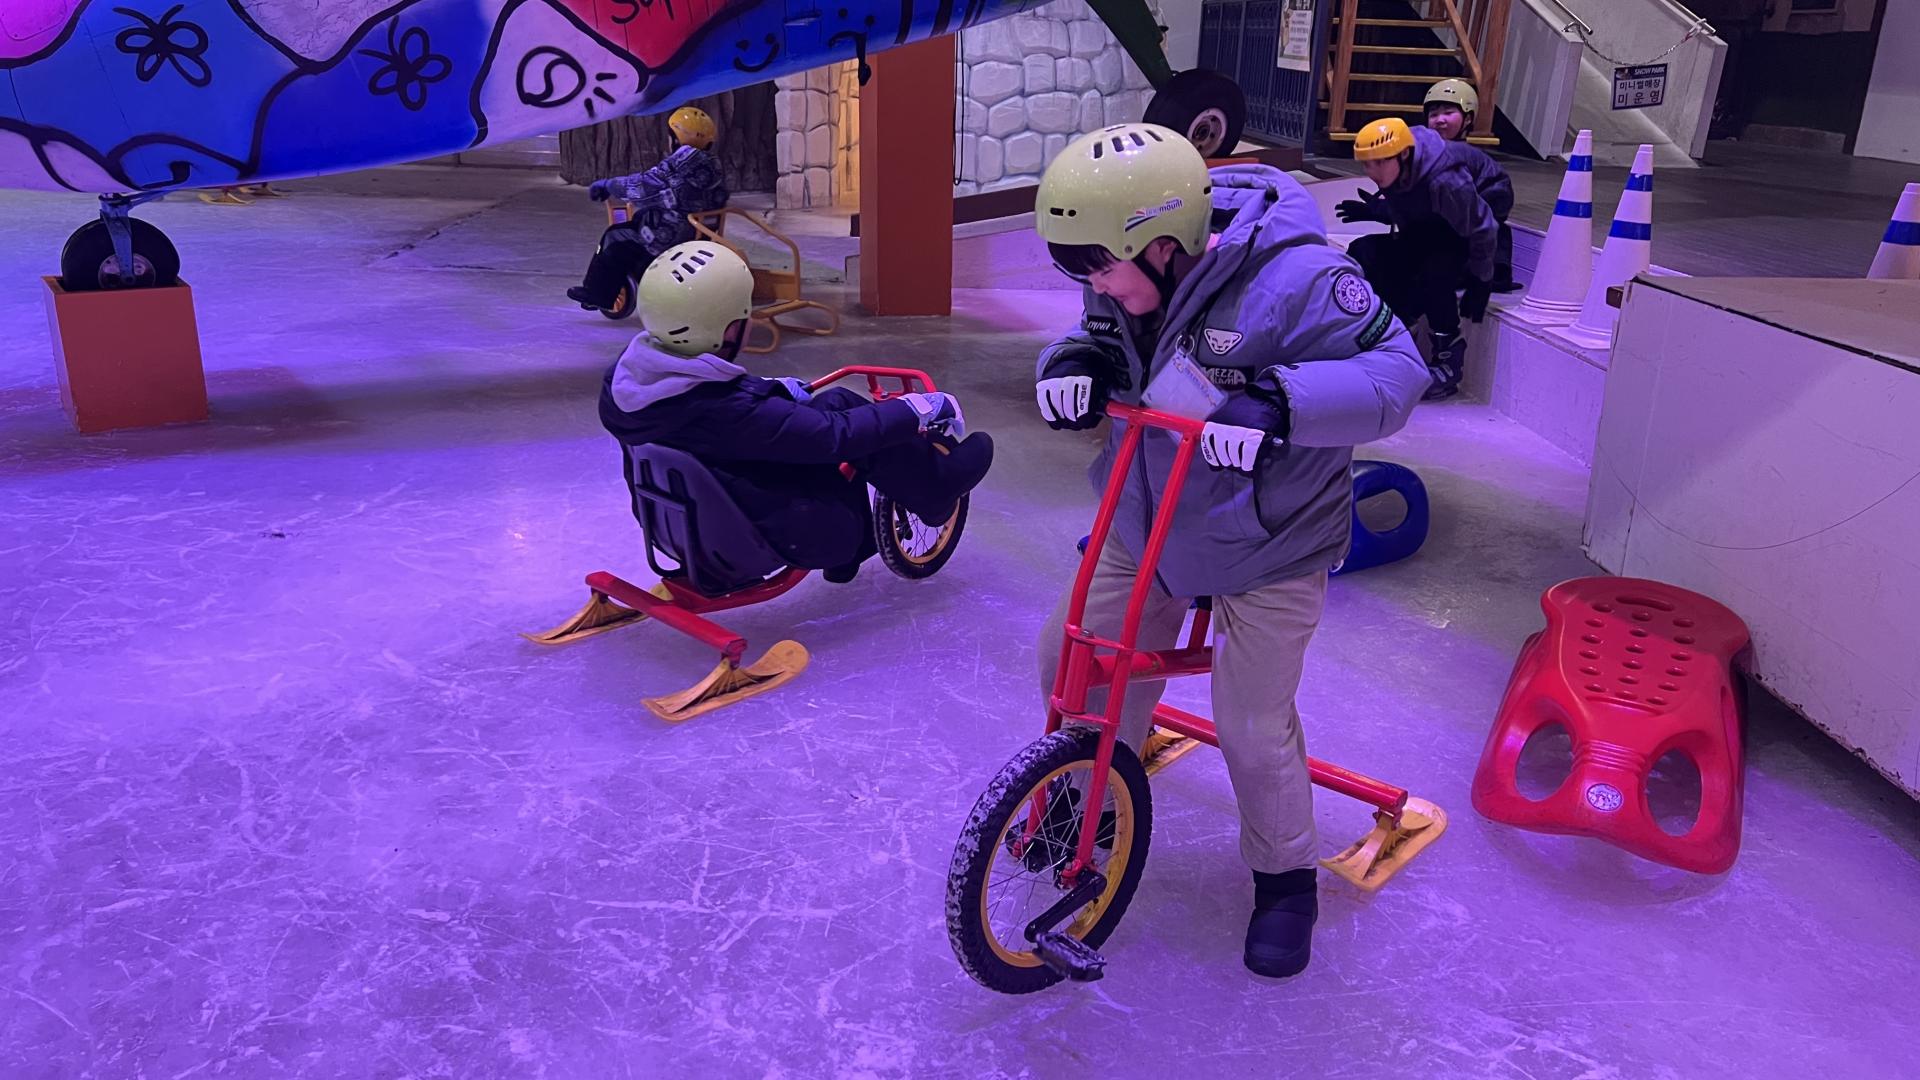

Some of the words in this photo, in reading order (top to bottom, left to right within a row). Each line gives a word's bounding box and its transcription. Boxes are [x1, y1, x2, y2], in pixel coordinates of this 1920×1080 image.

[1634, 67, 1652, 75] SNOW
[1651, 66, 1665, 74] PARK
[1620, 79, 1661, 91] 미니썰매장
